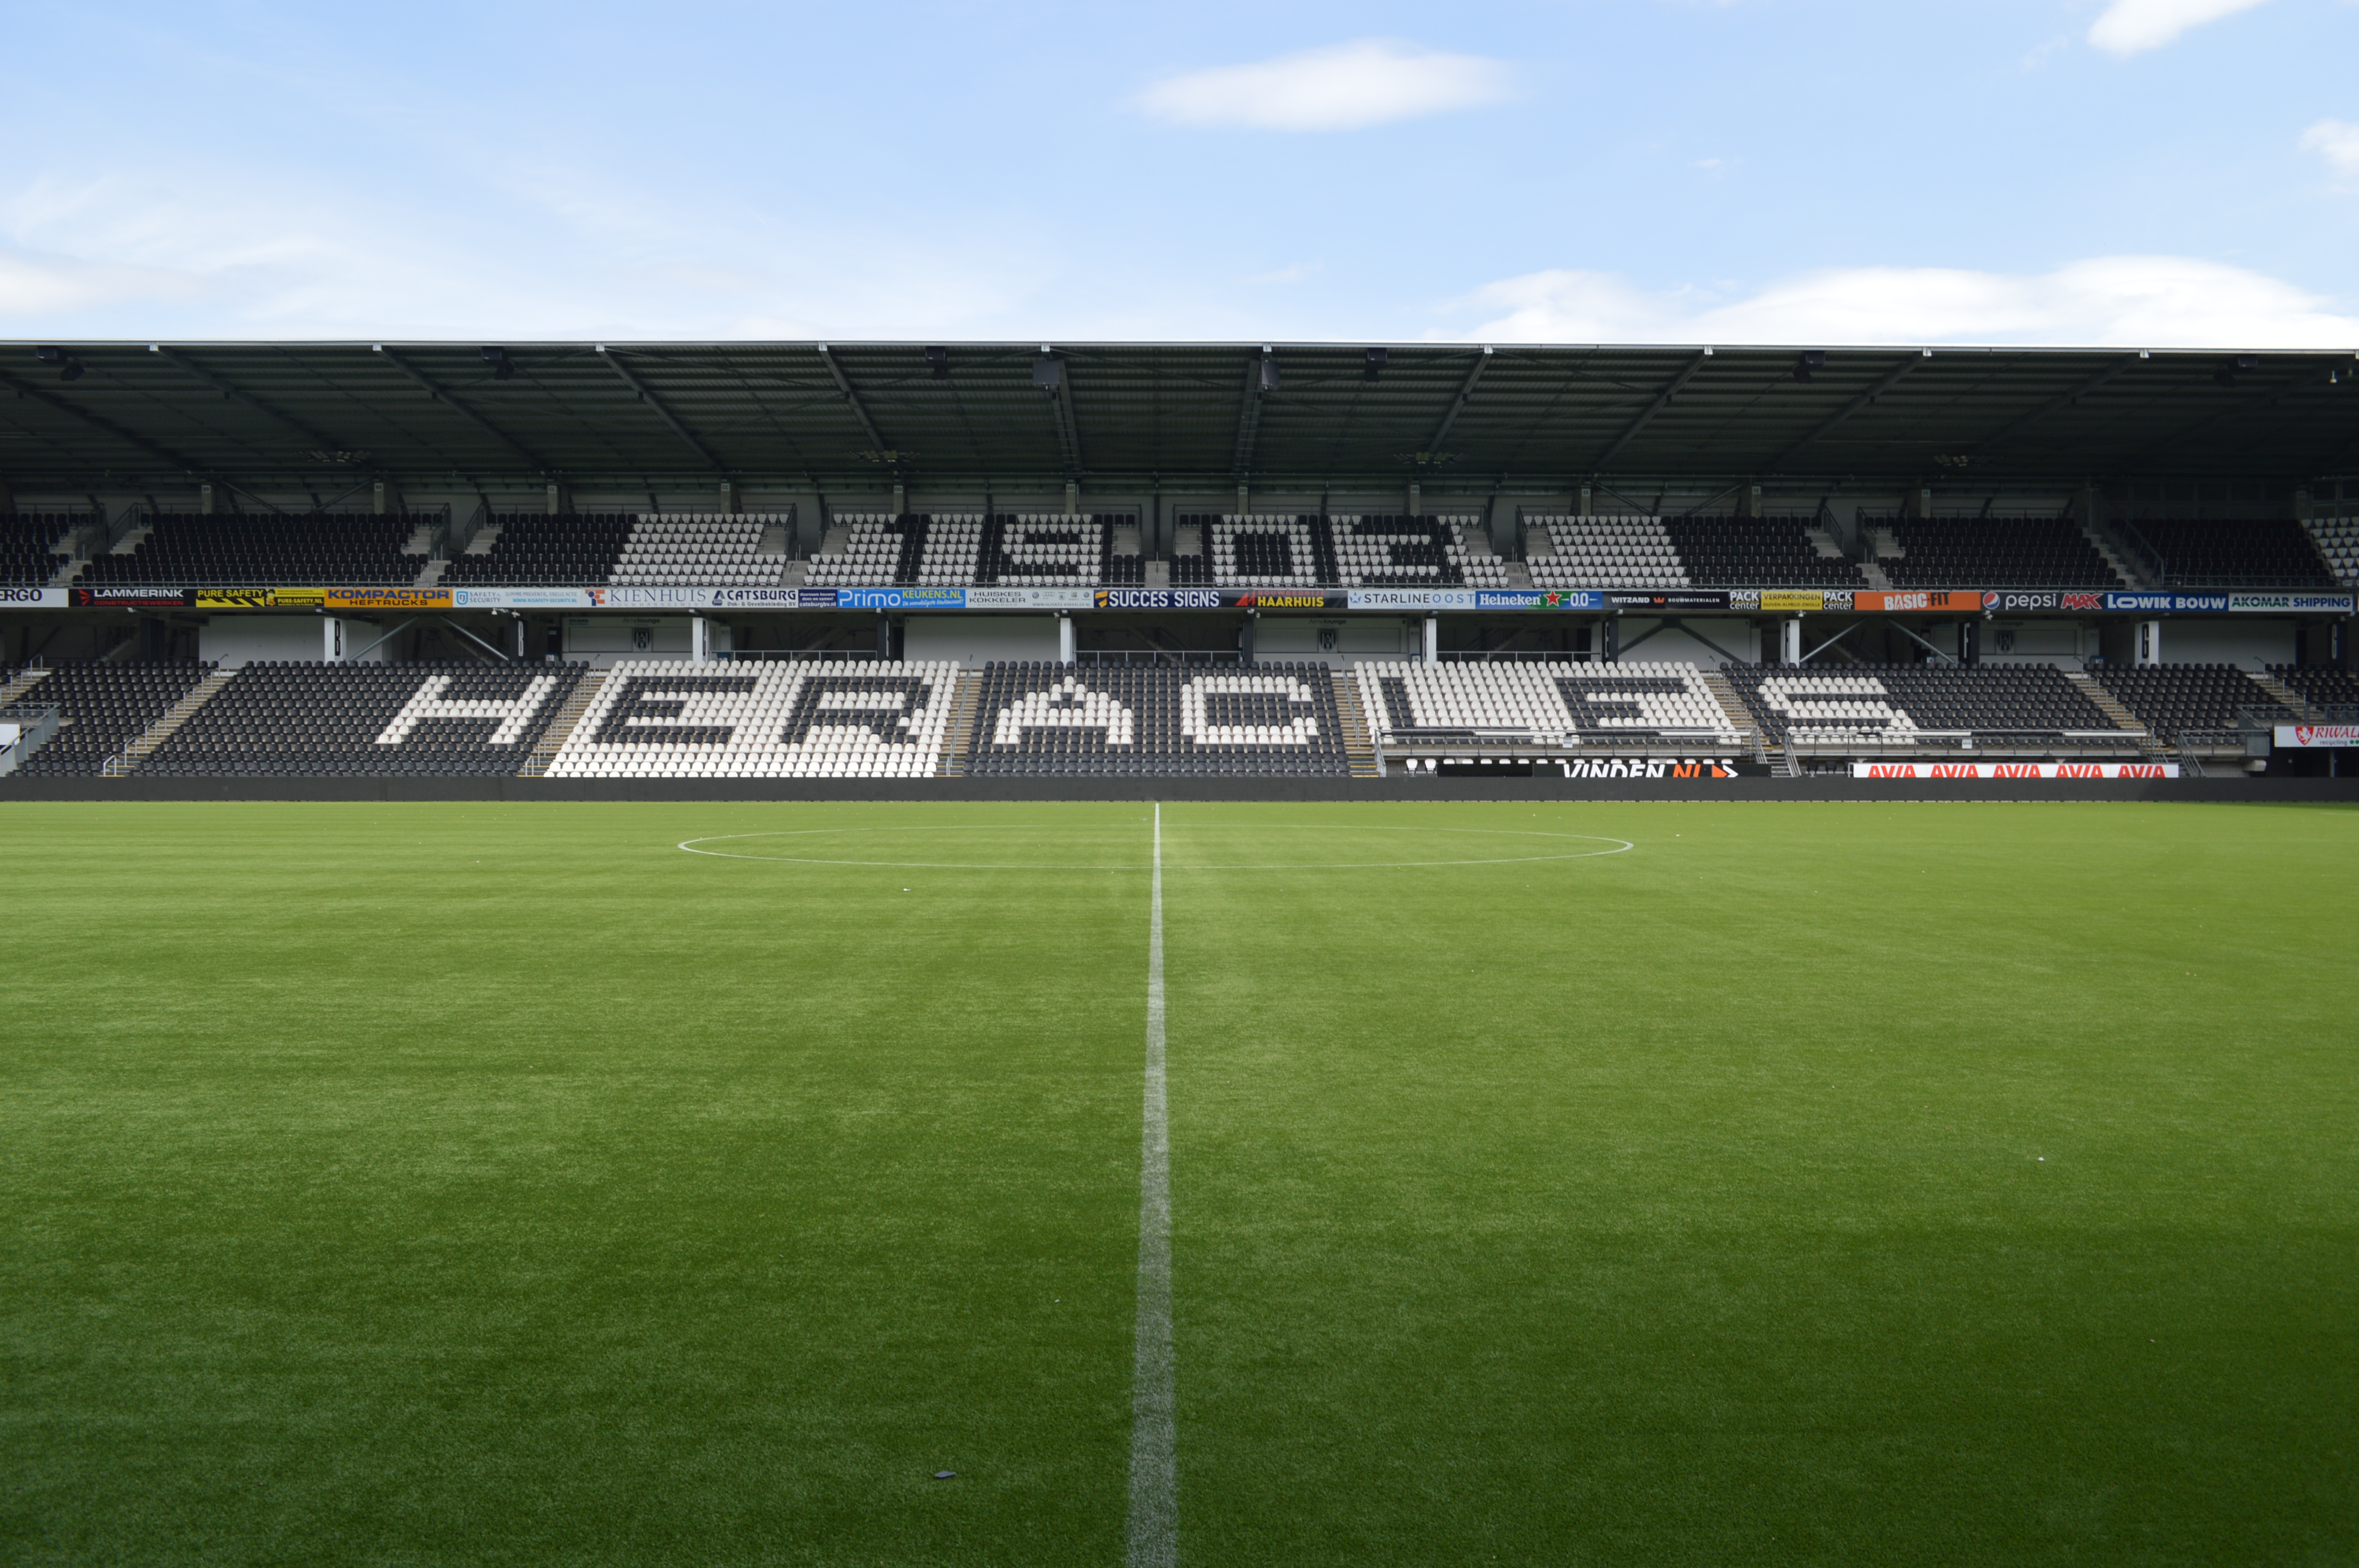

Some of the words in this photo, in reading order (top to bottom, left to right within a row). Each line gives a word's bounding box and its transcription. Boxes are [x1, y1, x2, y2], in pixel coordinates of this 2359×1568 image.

[328, 590, 450, 599] KOMPACTOR
[610, 589, 706, 602] KIENHUIS
[727, 590, 796, 601] CATSBURG
[839, 590, 900, 606] Primo
[902, 590, 963, 598] KEUKENS.NL
[1109, 591, 1168, 607] SUCCES
[1174, 591, 1219, 607] SIGNS
[1480, 594, 1541, 605] Heineken
[1571, 593, 1588, 607] 0.0
[1730, 592, 1759, 601] PACK
[1823, 592, 1852, 601] PACK
[1258, 597, 1324, 606] HAARHUIS
[2006, 594, 2056, 610] pepsi
[2060, 593, 2104, 610] MAX
[2175, 597, 2226, 609] BOUW
[2232, 597, 2289, 607] AKOMAR
[2293, 597, 2350, 607] SHIPPING
[335, 620, 340, 656] B
[518, 621, 524, 656] B
[2316, 727, 2359, 738] RIWAL
[1868, 764, 1916, 777] AVIA
[1930, 764, 1978, 777] AVIA
[1993, 764, 2042, 777] AVIA
[2055, 764, 2104, 777] AVIA
[2117, 764, 2166, 777] AVIA
